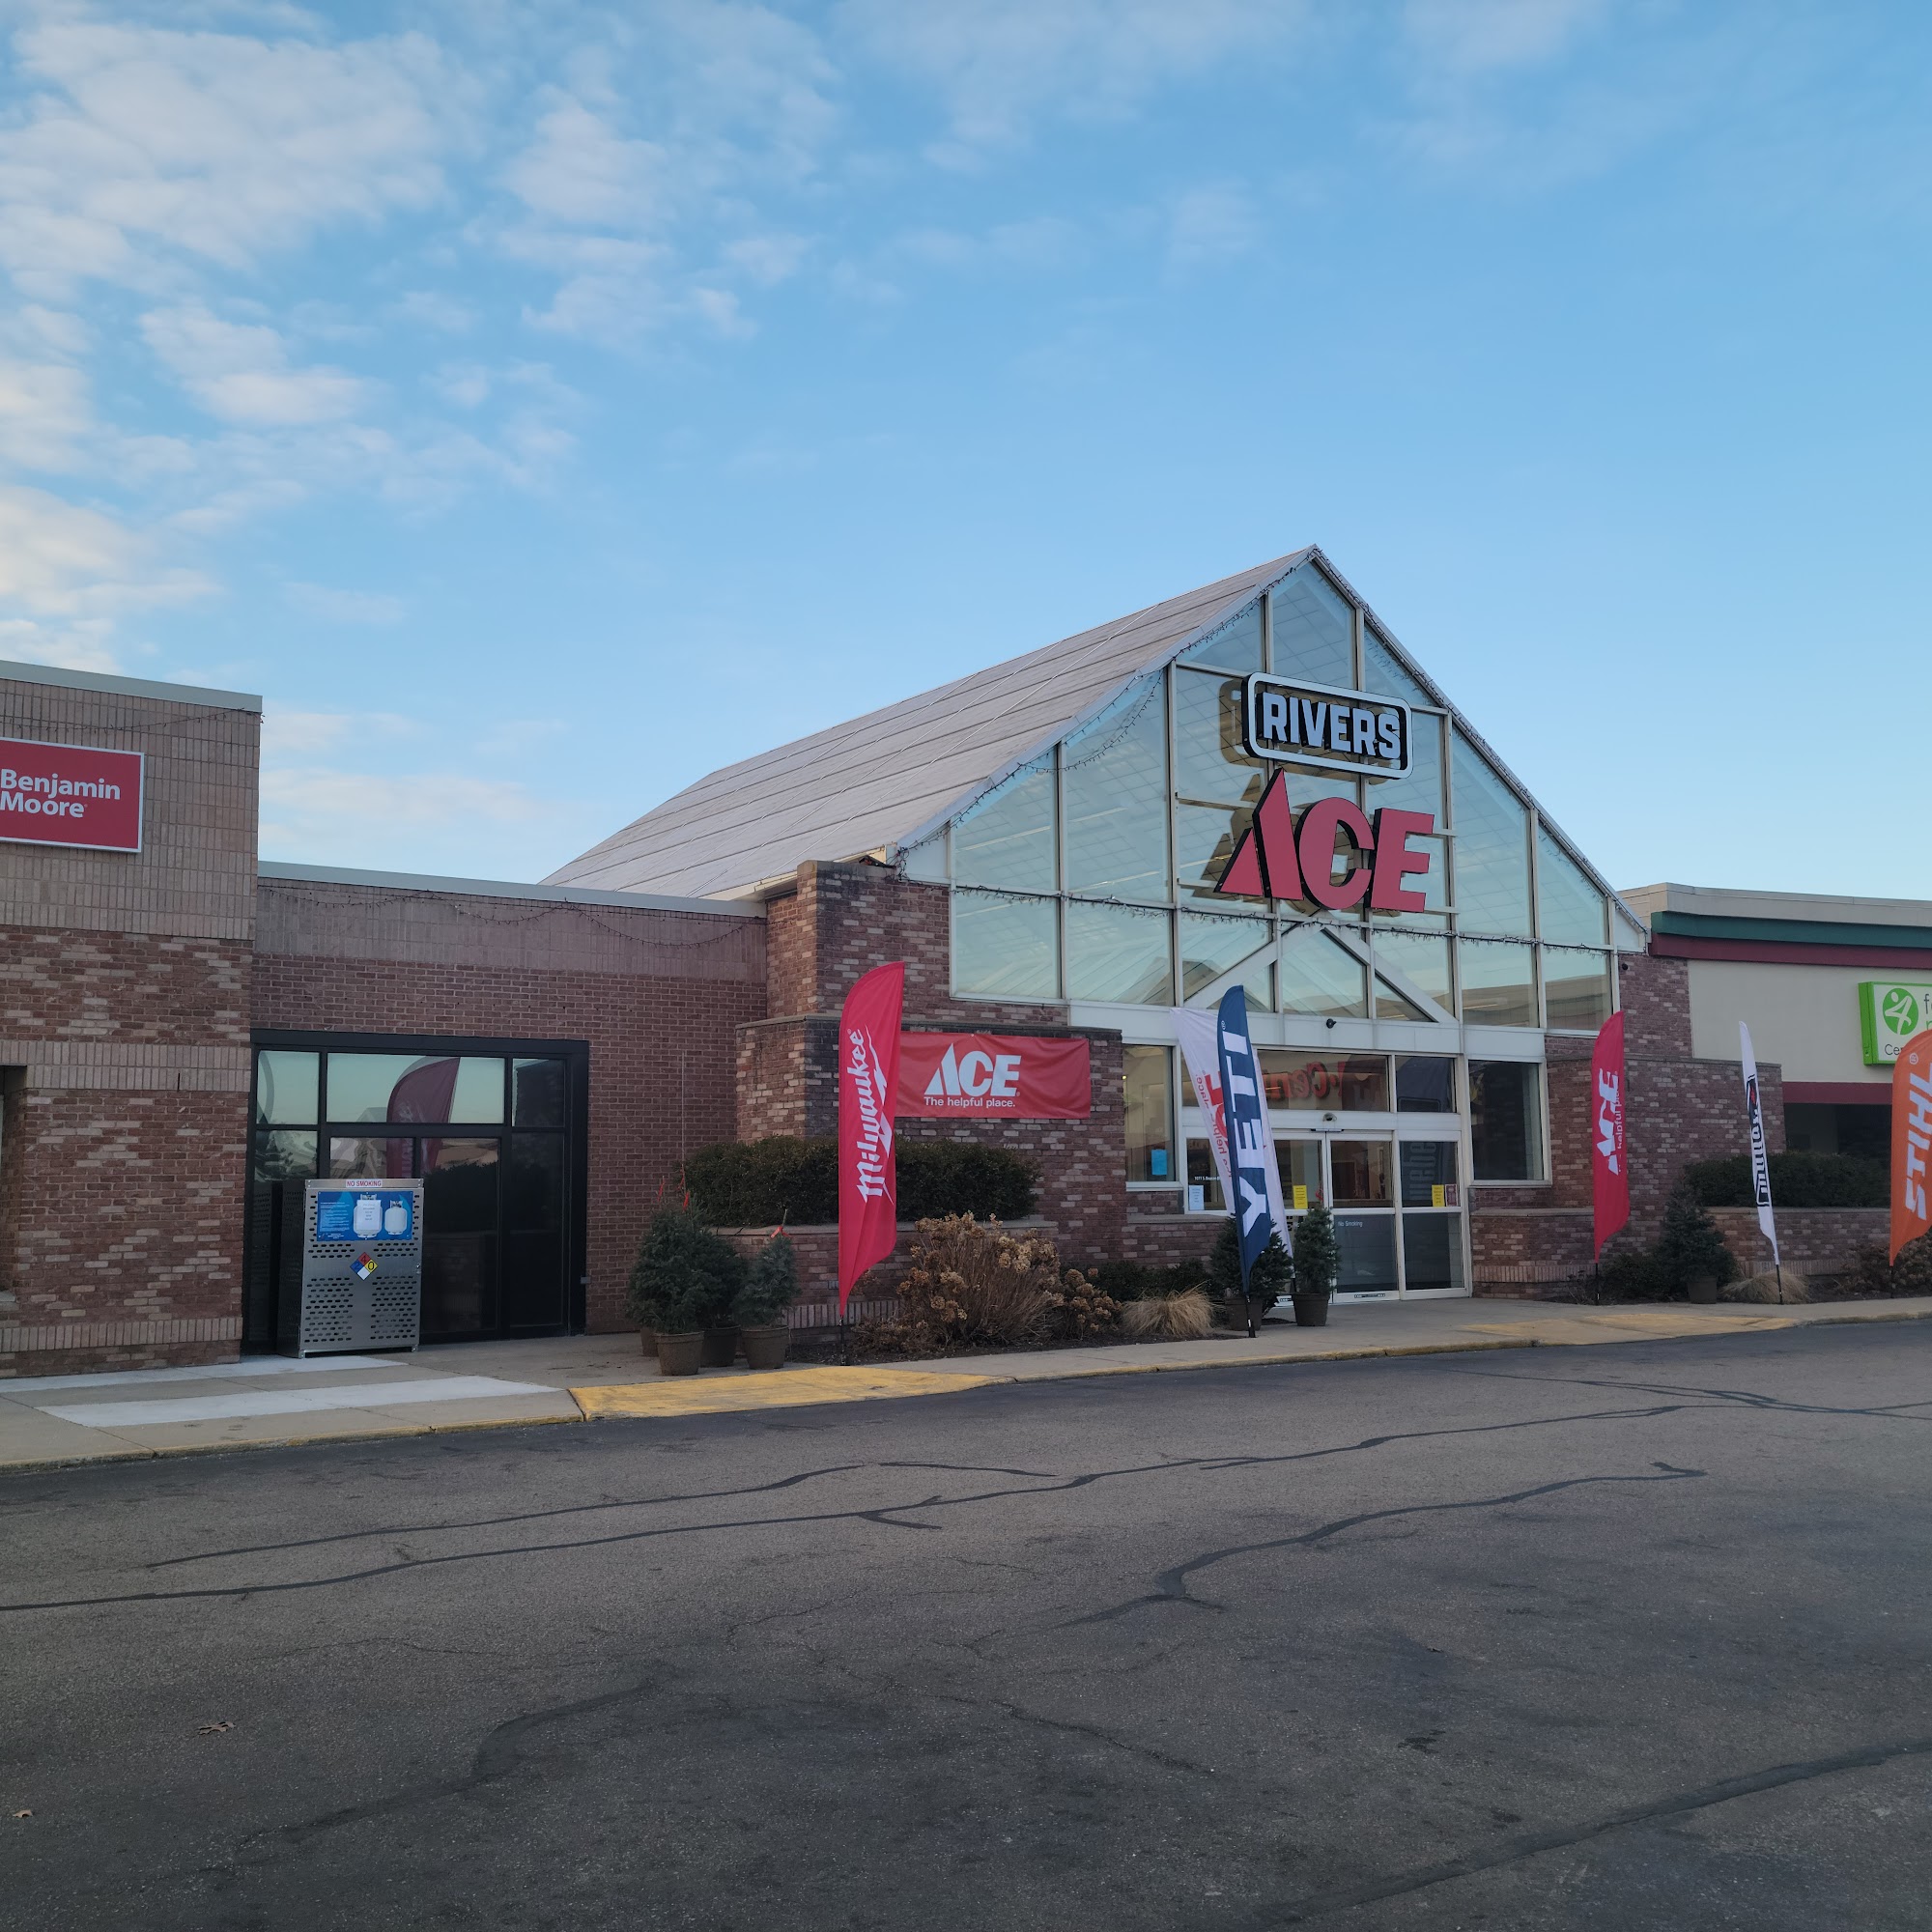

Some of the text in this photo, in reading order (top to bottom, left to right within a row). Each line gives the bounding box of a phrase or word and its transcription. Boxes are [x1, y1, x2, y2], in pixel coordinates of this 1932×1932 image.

[1263, 692, 1401, 759] RIVERS
[0, 769, 121, 800] Benjamin
[0, 791, 85, 818] Moore
[1214, 769, 1435, 913] ACE
[924, 1043, 1021, 1096] ACE
[847, 1029, 885, 1203] Milwaukee
[924, 1097, 1016, 1109] The helpful place.
[1222, 1031, 1266, 1237] YETI
